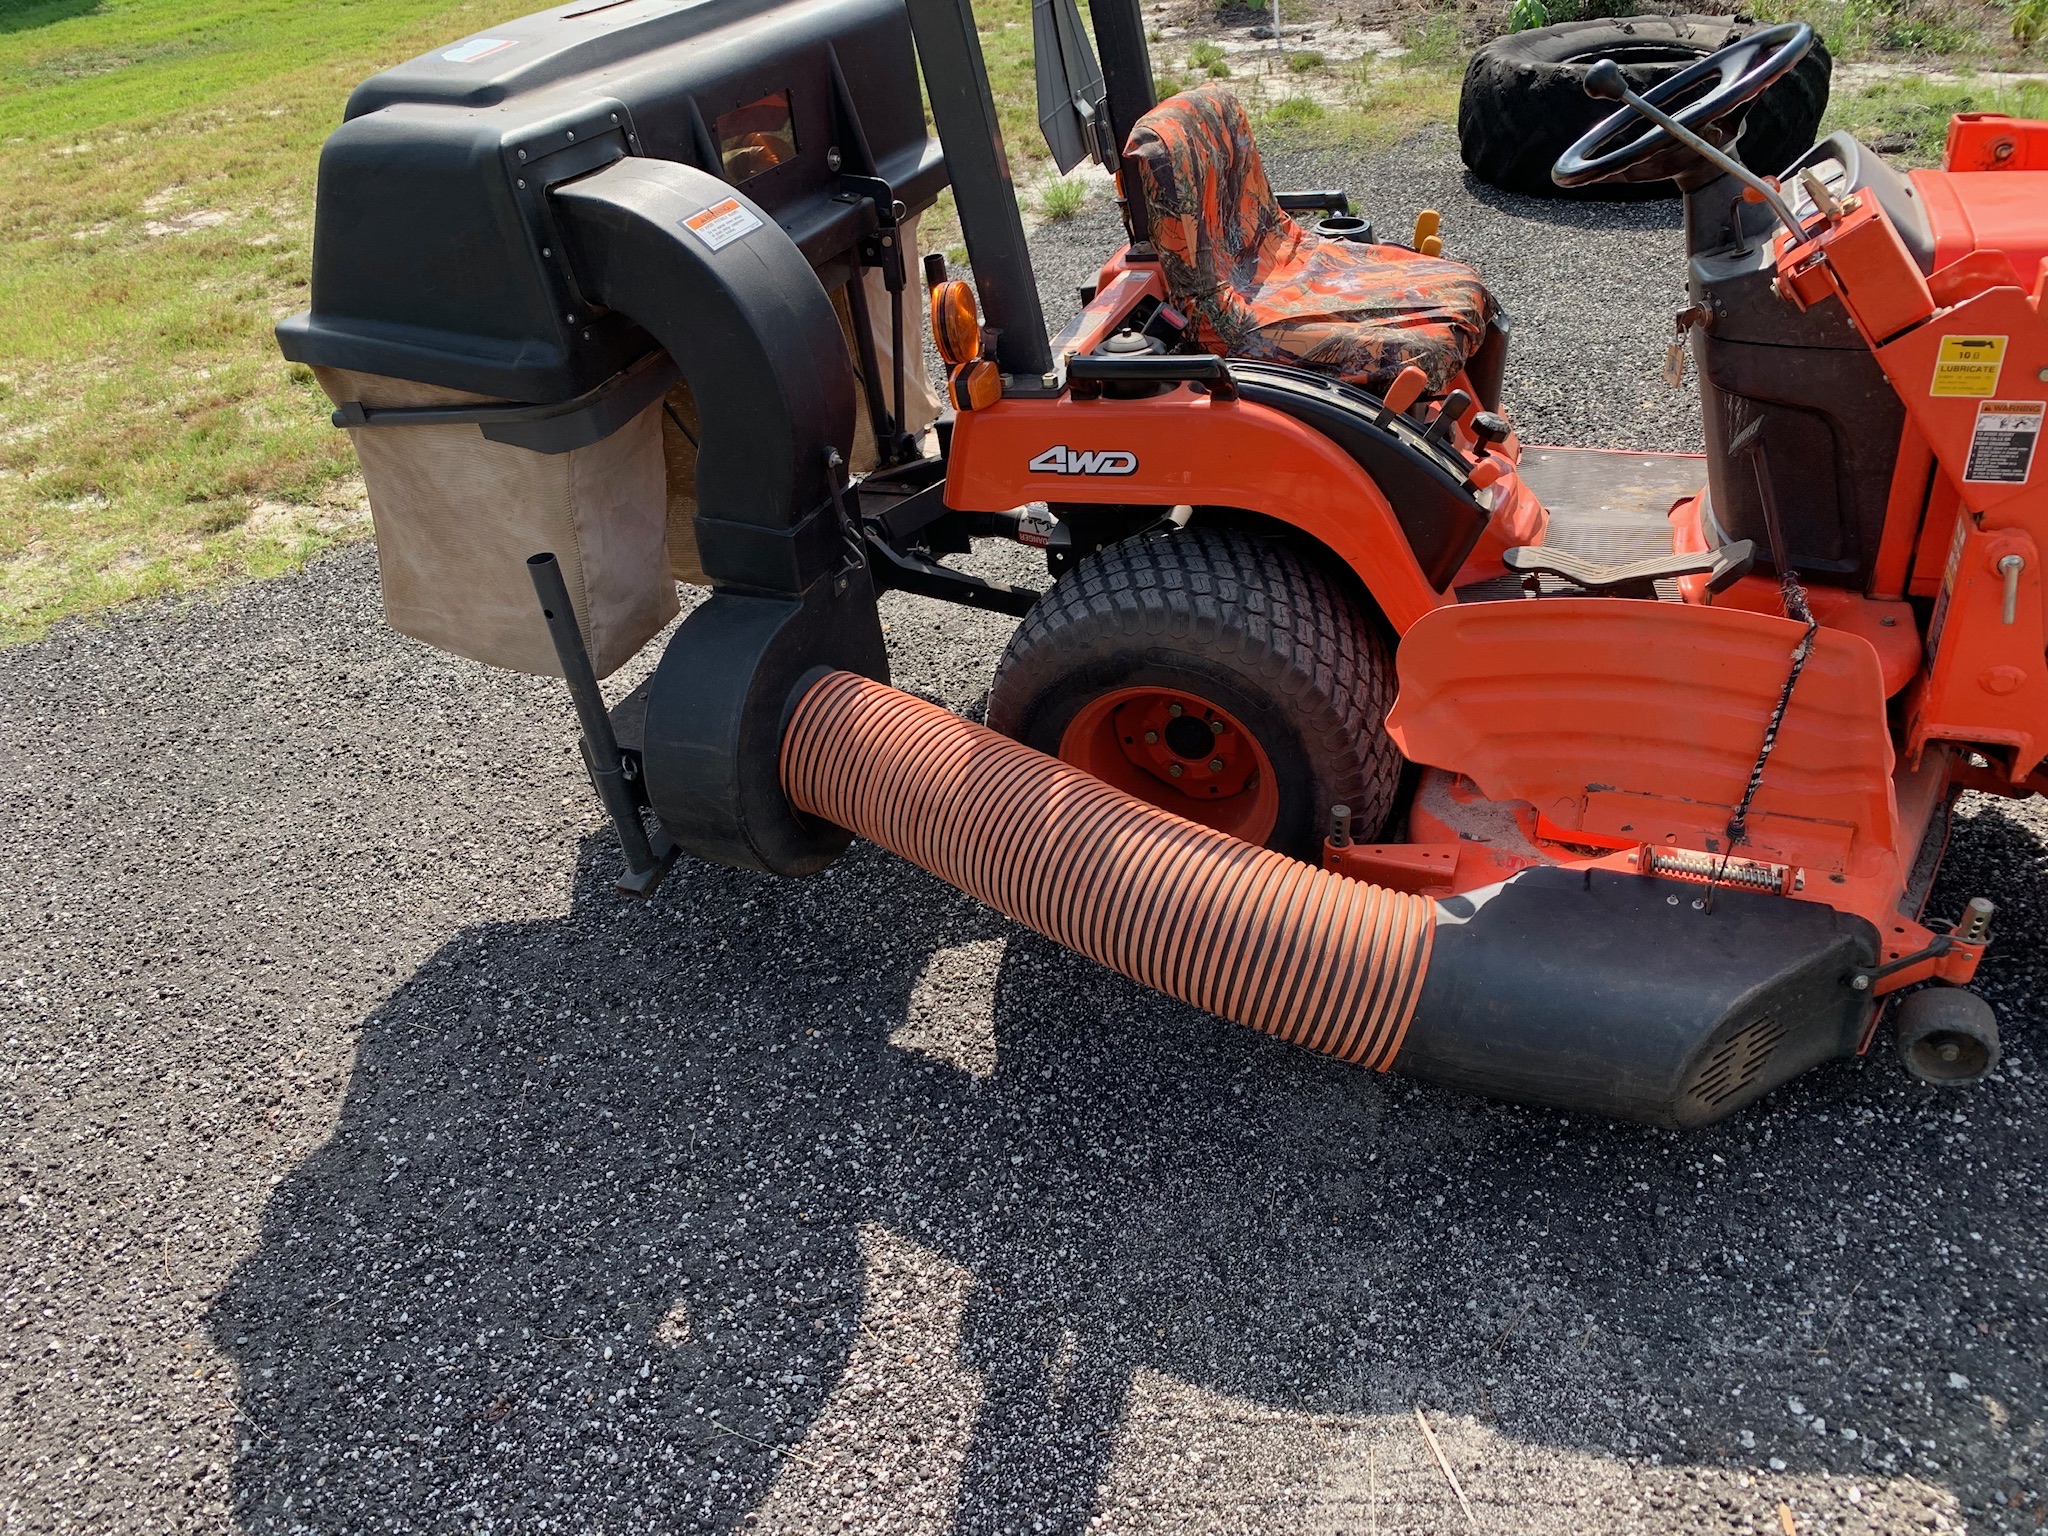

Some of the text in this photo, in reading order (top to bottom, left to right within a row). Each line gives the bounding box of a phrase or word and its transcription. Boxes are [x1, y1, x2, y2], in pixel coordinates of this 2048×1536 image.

[1959, 351, 1971, 359] 10
[1940, 365, 1996, 373] LUBRICATE
[1994, 404, 2041, 412] WARNING
[1028, 445, 1138, 475] 4WD
[1020, 533, 1049, 545] DANGER
